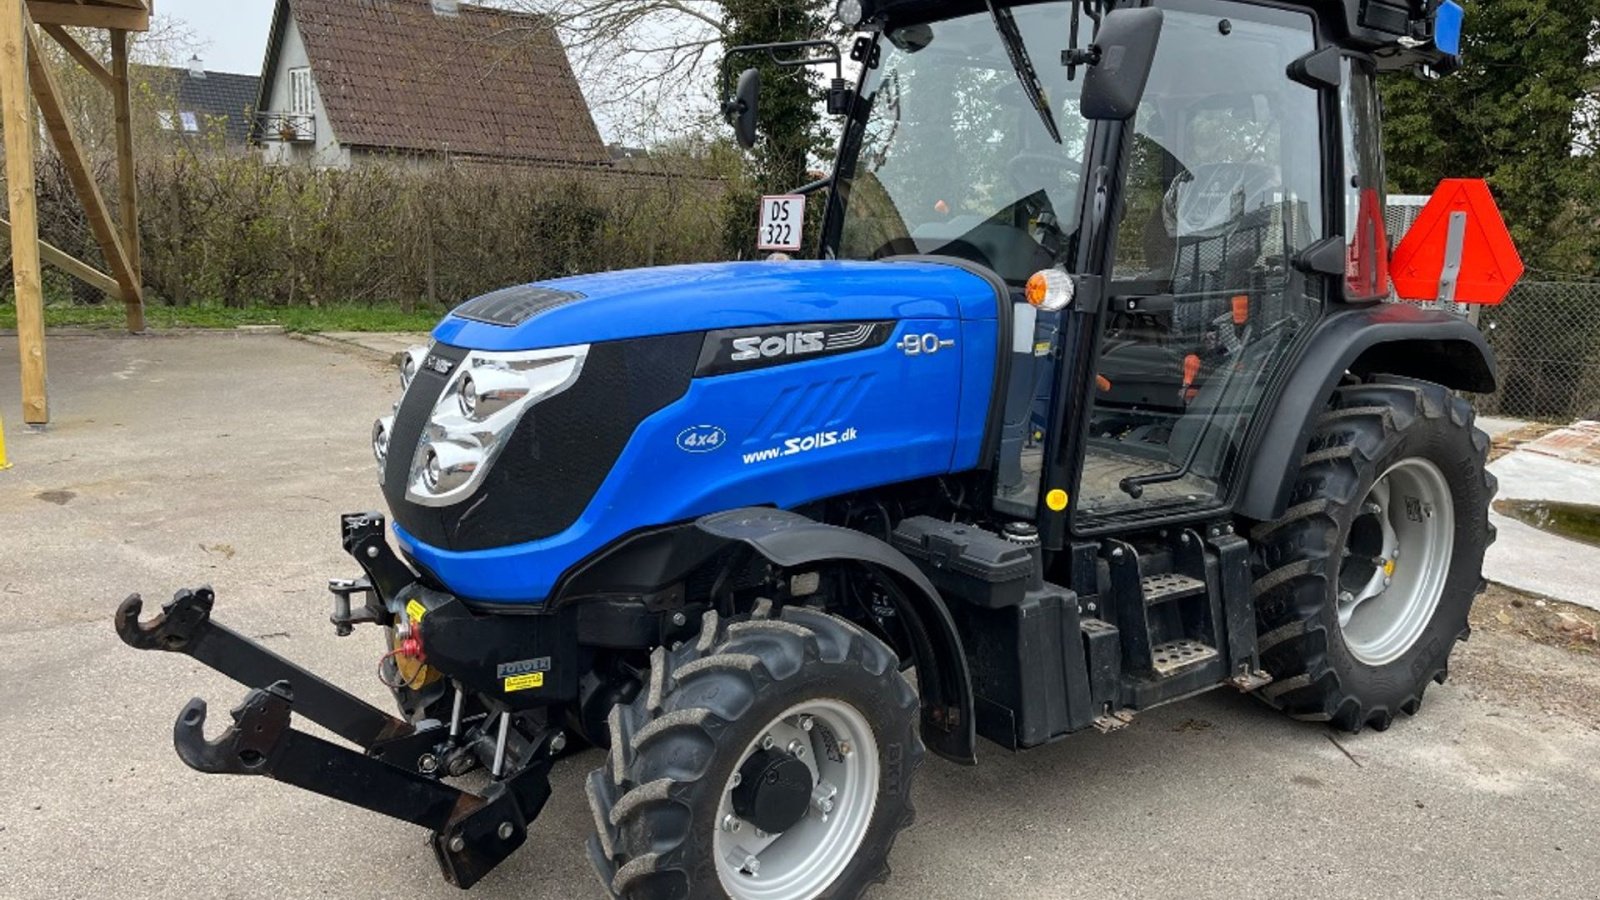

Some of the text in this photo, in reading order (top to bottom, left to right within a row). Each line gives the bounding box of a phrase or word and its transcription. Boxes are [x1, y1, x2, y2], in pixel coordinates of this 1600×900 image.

[771, 200, 790, 221] DS
[766, 223, 791, 245] 322
[684, 431, 720, 447] 4x4
